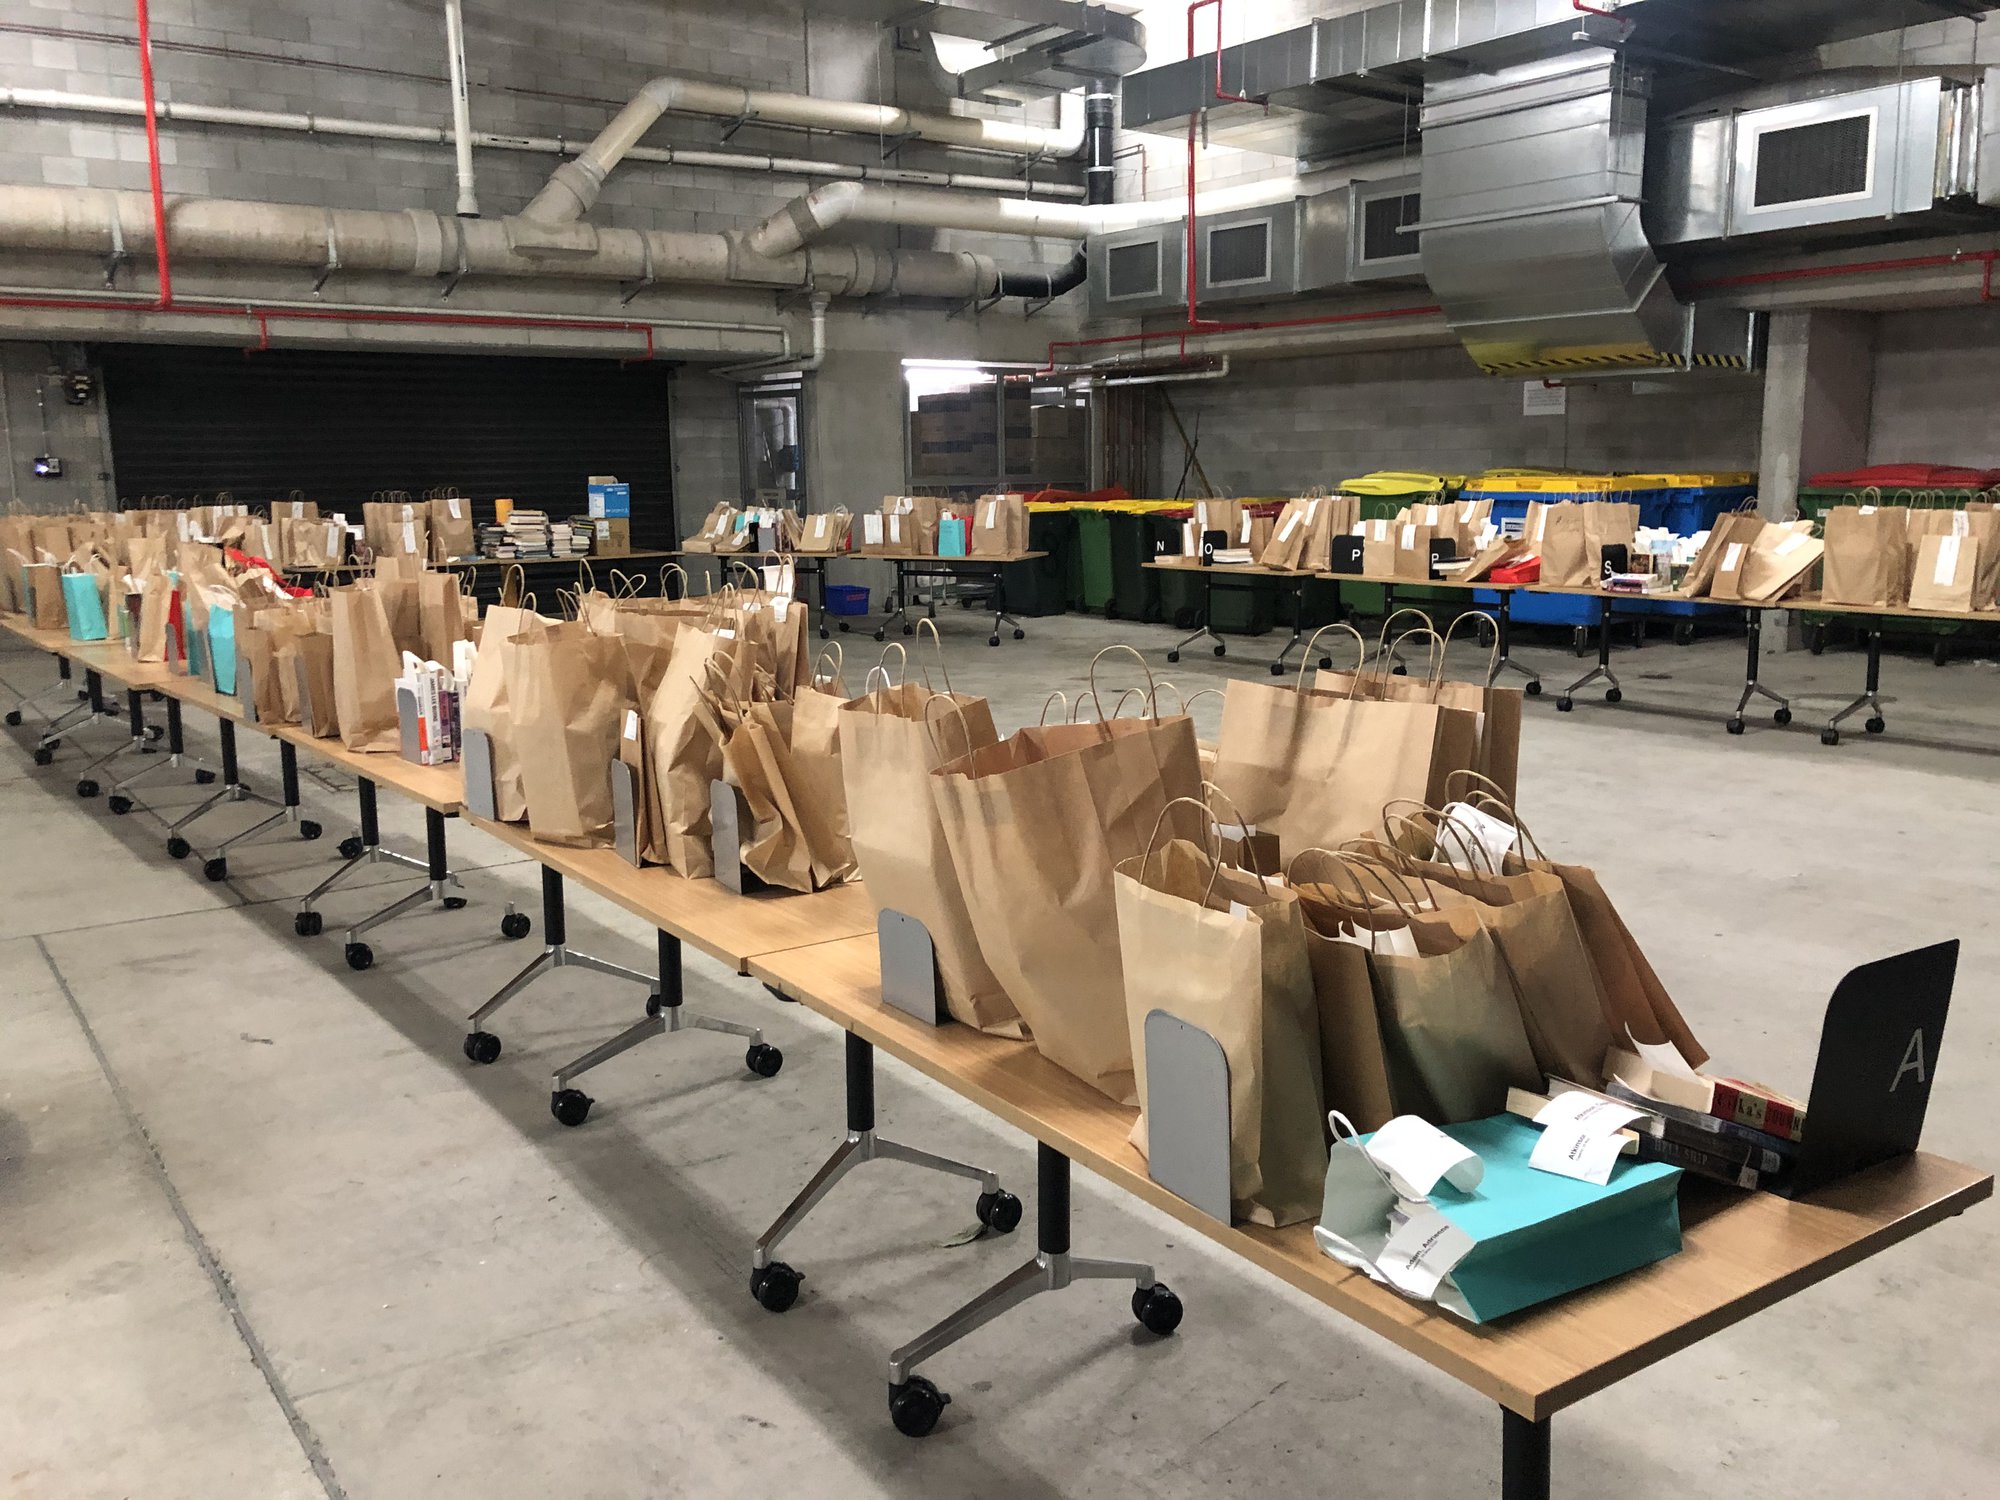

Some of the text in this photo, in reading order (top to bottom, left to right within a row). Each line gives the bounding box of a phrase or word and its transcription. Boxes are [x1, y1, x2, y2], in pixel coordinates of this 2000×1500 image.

[1156, 540, 1165, 552] N
[1204, 543, 1213, 555] O
[1351, 549, 1361, 561] P
[1431, 553, 1440, 563] P
[1604, 560, 1612, 575] S
[1889, 1027, 1925, 1092] A
